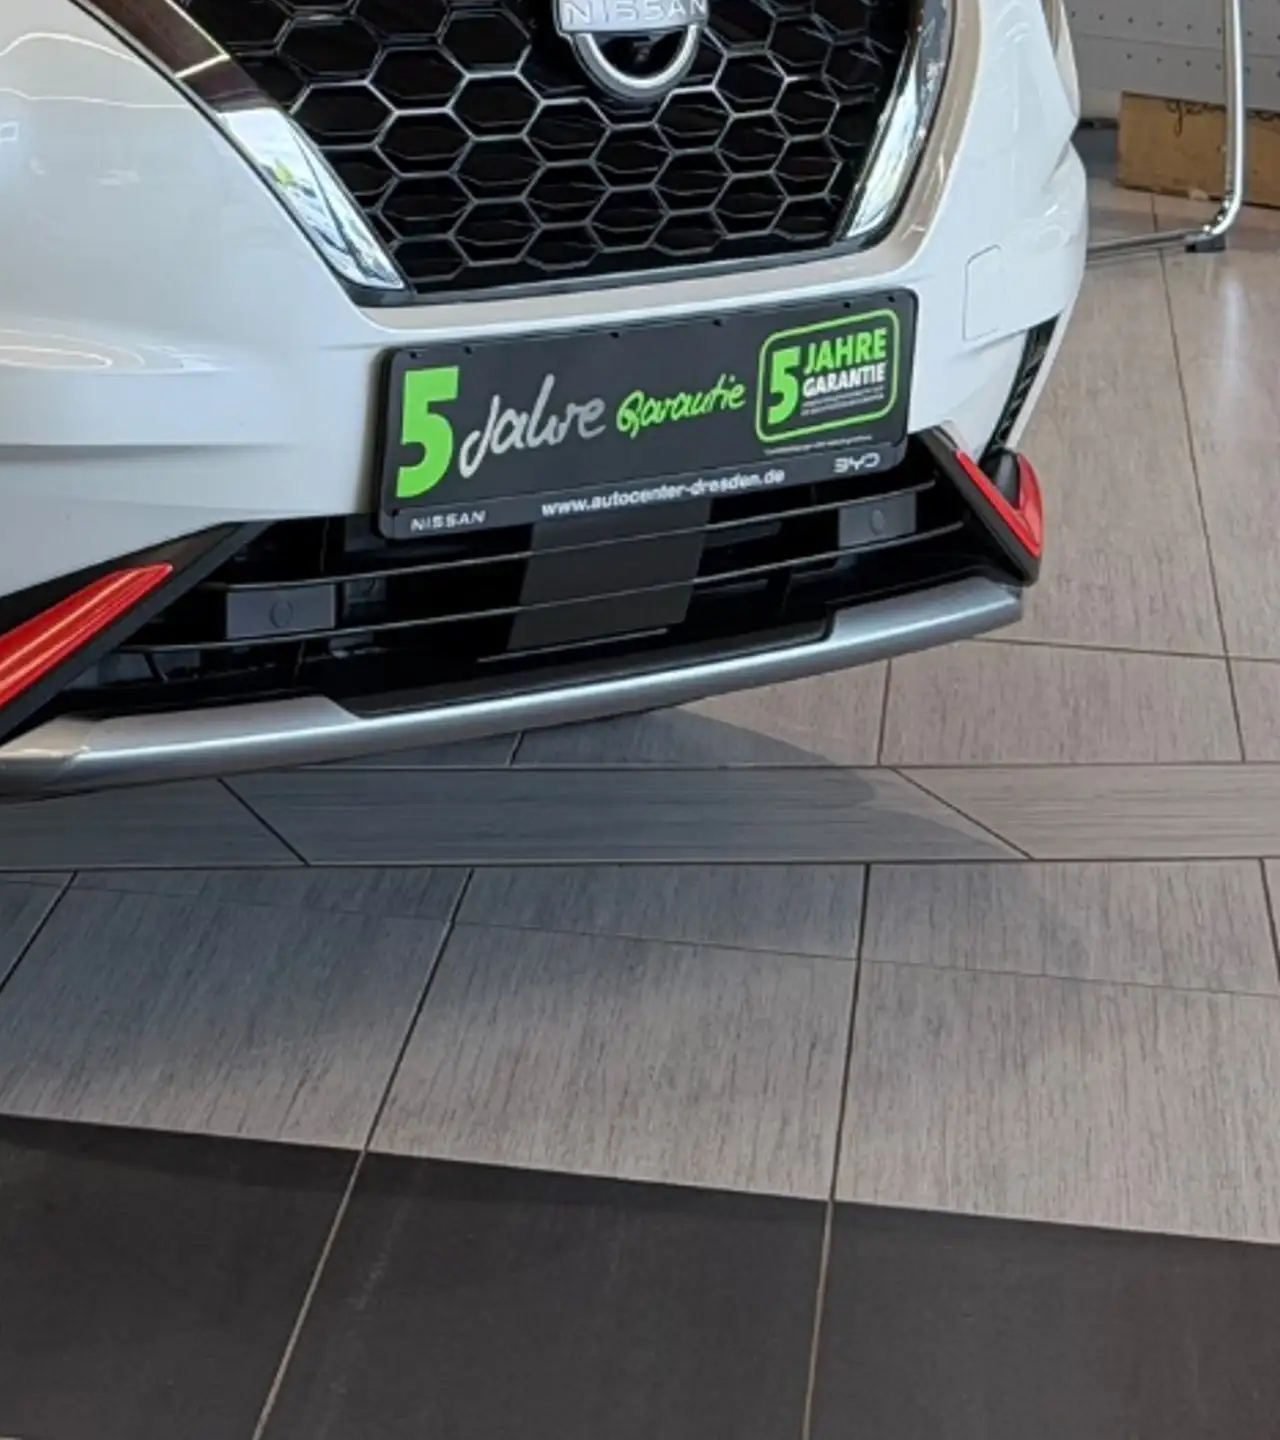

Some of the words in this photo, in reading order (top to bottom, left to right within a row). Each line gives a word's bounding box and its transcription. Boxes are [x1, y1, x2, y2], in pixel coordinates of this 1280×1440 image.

[767, 346, 801, 425] 5
[803, 327, 888, 376] JAHRE
[802, 361, 886, 398] GARANTIE
[396, 366, 460, 498] 5
[459, 373, 607, 479] Jahre
[616, 373, 746, 440] Garantie
[833, 452, 881, 474] BYD
[541, 468, 785, 516] www.autocenter-dresden.de
[410, 511, 487, 532] NISSAN
